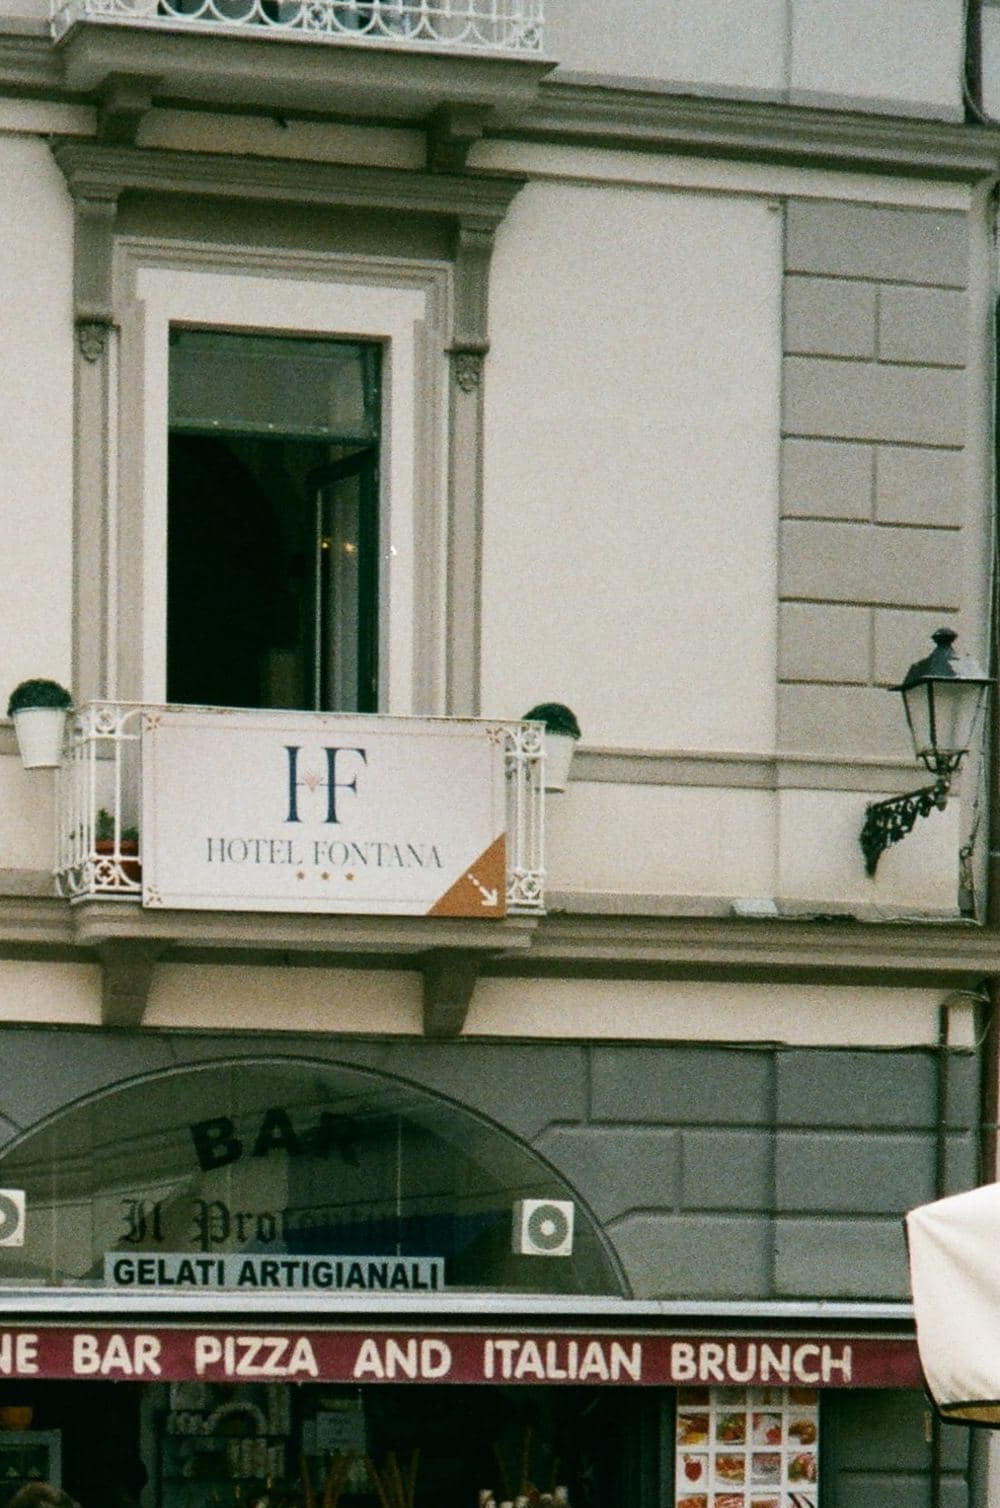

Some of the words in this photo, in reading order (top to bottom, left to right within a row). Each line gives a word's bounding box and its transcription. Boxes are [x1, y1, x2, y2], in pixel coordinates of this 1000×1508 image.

[283, 745, 368, 824] HF
[206, 837, 303, 865] HOTEL
[312, 840, 444, 868] FONTANA
[191, 1107, 362, 1171] BAR
[112, 1258, 226, 1286] GELATI
[237, 1260, 438, 1290] ARTIGIANALI
[72, 1334, 162, 1376] BAR
[194, 1336, 319, 1378] PIZZA
[353, 1338, 453, 1379] AND
[483, 1339, 642, 1381] ITALIAN
[670, 1342, 853, 1383] BRUNCH
